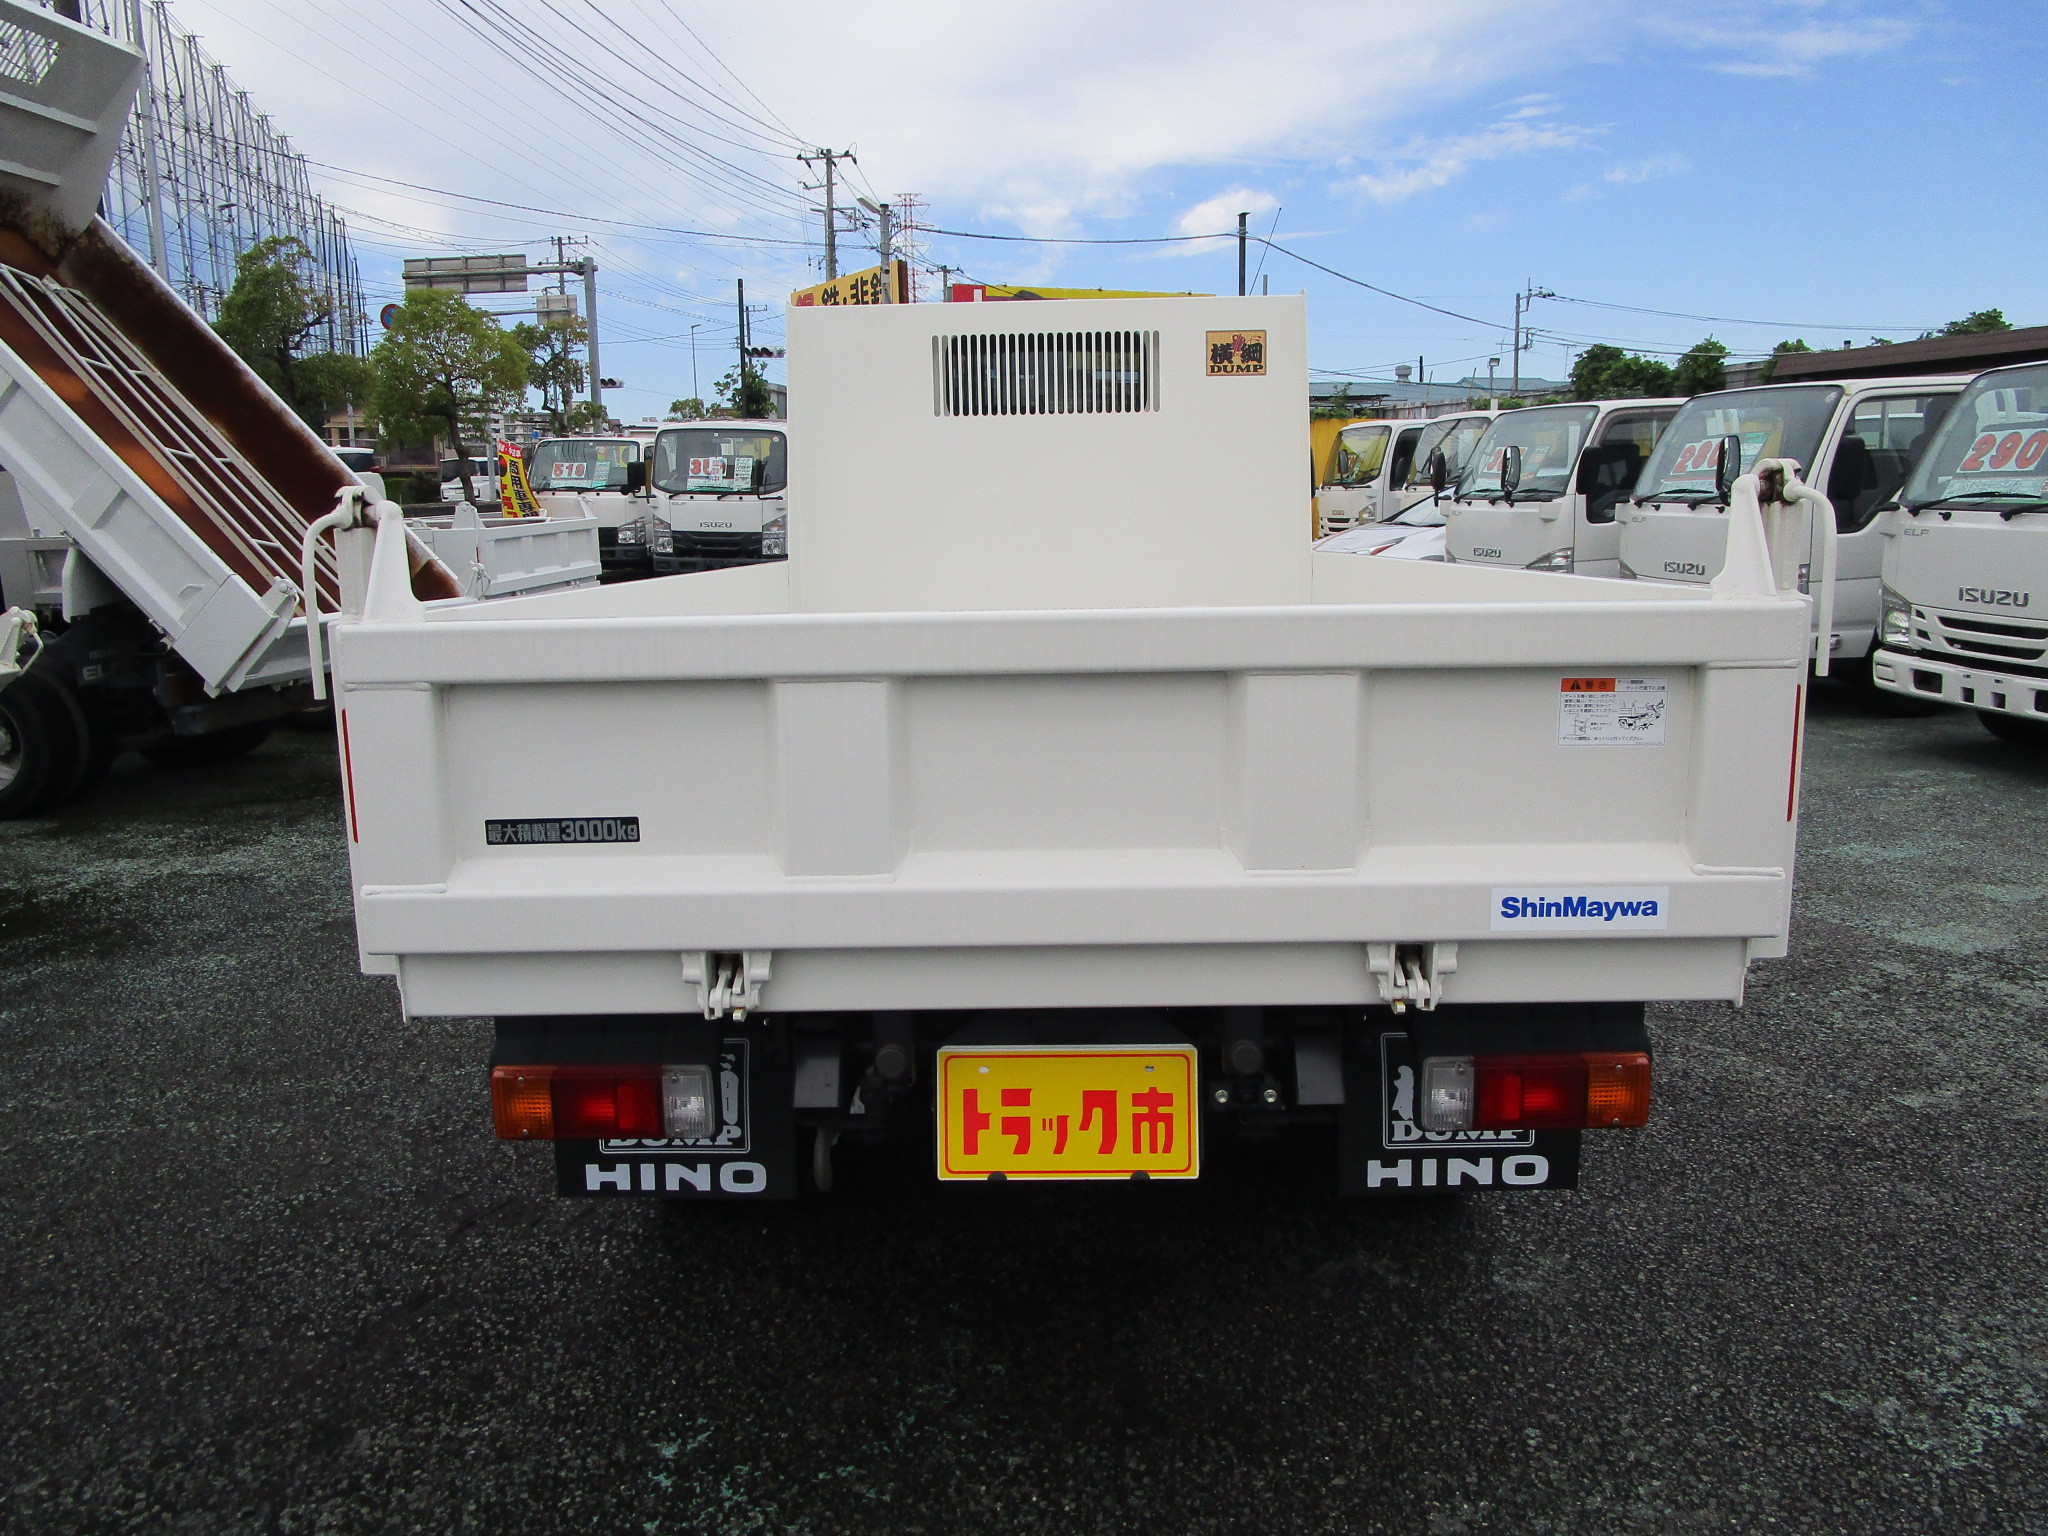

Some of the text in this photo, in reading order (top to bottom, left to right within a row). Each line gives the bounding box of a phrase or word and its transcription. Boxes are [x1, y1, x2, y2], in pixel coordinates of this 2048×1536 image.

[1210, 364, 1263, 374] DUMP
[1960, 430, 2048, 471] 290
[699, 521, 733, 529] ISUZU
[1903, 528, 1930, 537] ELF
[1473, 547, 1502, 558] ISUZU
[1664, 561, 1706, 576] ISUZU
[1958, 586, 2030, 608] ISUZU
[487, 820, 638, 843] 最大積載量3000kg
[1501, 896, 1658, 921] ShinMaywa
[963, 1086, 1174, 1155] トラック市
[585, 1162, 767, 1193] HINO
[1367, 1155, 1549, 1188] HINO
